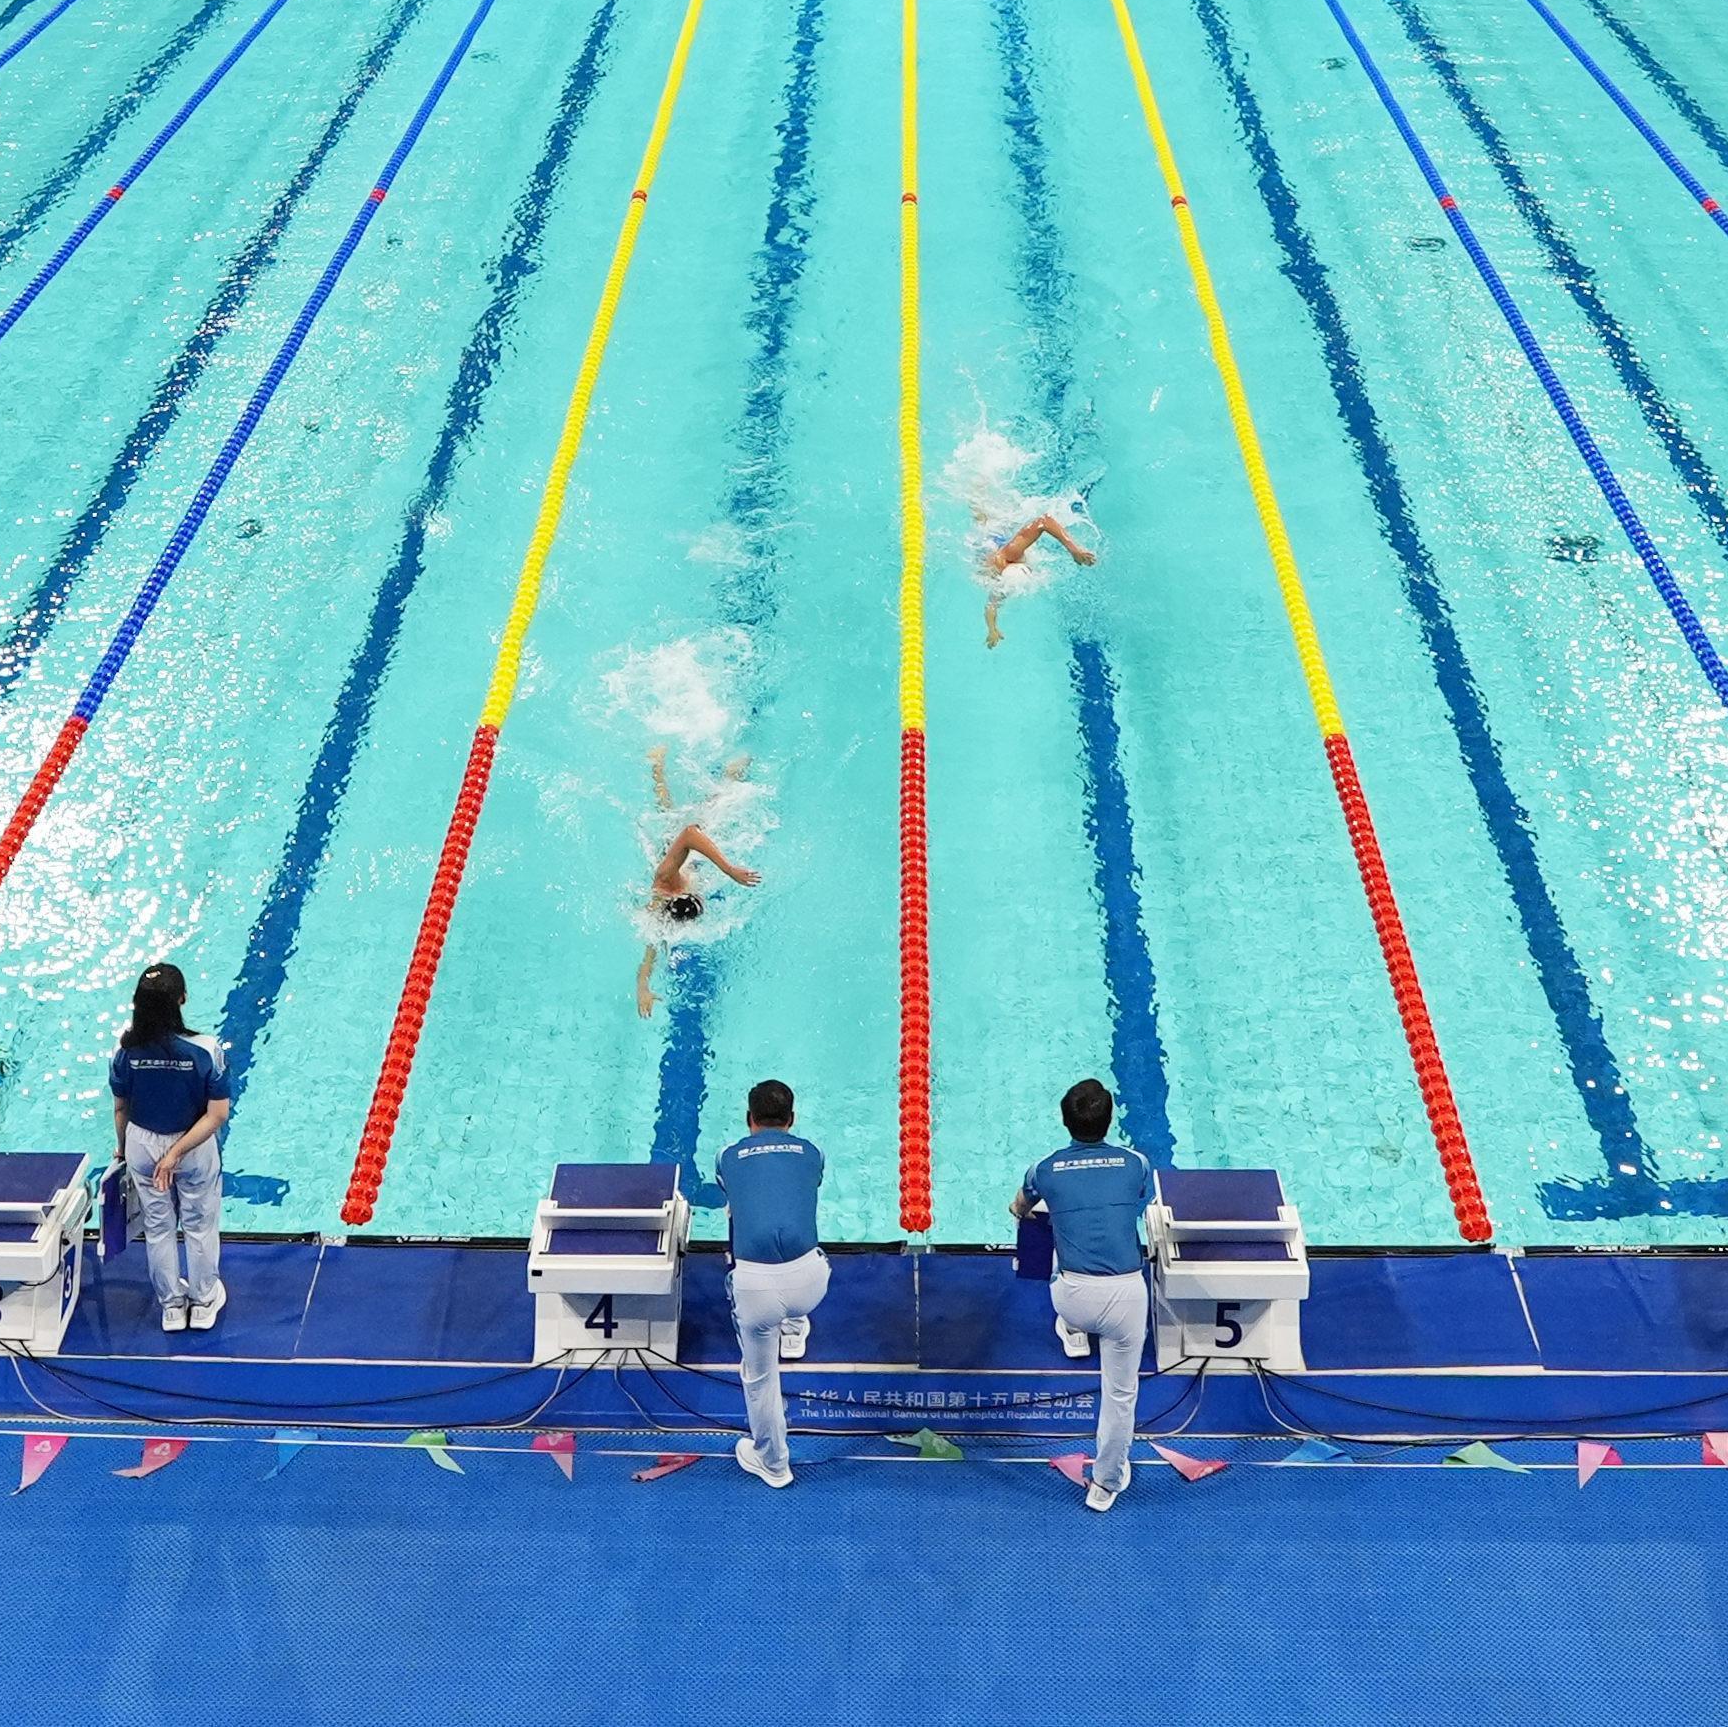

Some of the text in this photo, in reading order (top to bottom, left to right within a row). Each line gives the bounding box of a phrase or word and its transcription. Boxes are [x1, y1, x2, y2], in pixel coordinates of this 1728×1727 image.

[583, 1294, 619, 1340] 4
[1213, 1301, 1244, 1349] 5
[800, 1408, 820, 1419] The
